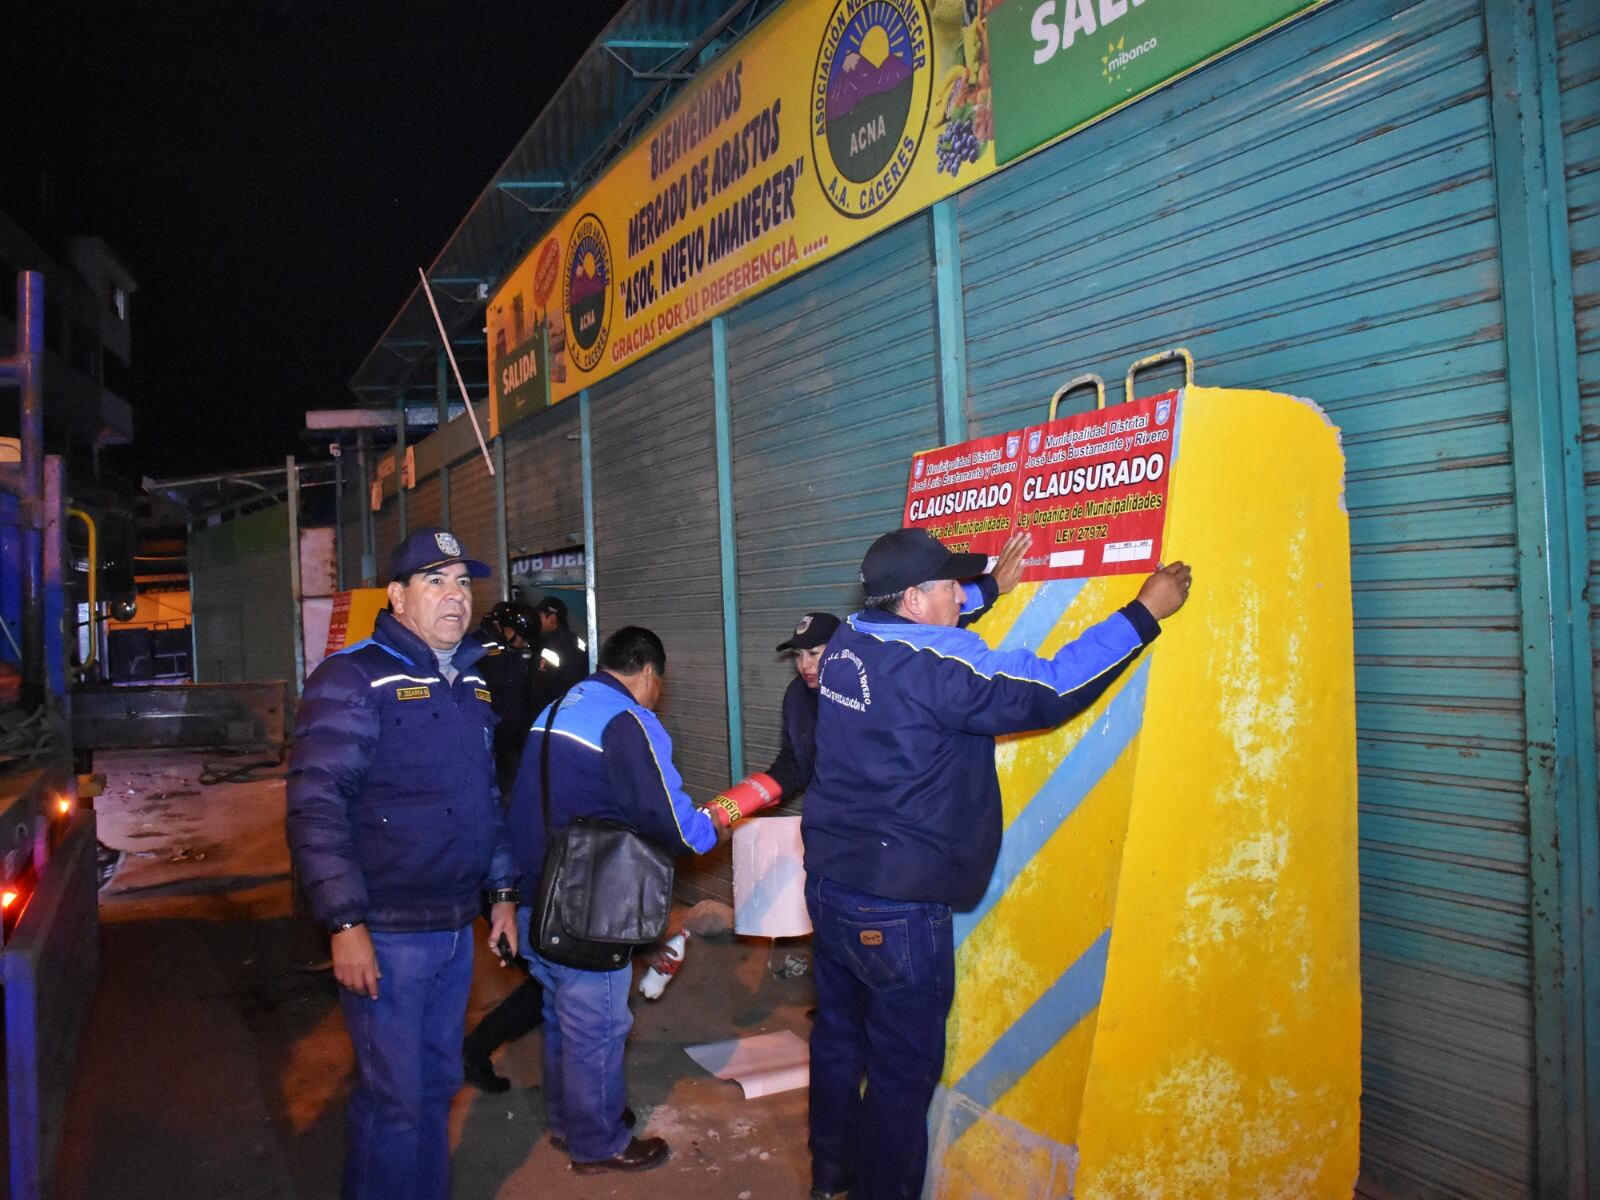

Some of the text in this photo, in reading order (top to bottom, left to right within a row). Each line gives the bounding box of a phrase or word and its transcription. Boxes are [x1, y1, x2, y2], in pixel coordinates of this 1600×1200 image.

[1030, 0, 1146, 65] SAL
[816, 0, 926, 137] ASOCIACIÓN ANECER
[1107, 36, 1157, 72] mibanco
[651, 60, 743, 181] BIENVENIDOS
[850, 115, 886, 157] ACNA
[628, 98, 781, 259] MERCADO DE ABASTOS
[829, 136, 914, 211] A.A. CÁCERES
[620, 260, 658, 319] "ASOC.
[661, 225, 705, 296] NUEVO
[708, 156, 804, 265] AMANECER"
[579, 310, 596, 333] ACNA
[611, 325, 656, 362] GRACIAS
[657, 303, 683, 337] POR
[684, 296, 699, 322] SU
[502, 349, 537, 395] SALIDA
[1025, 429, 1169, 469] José Luis Bustamante y Rivero
[1045, 413, 1150, 449] Municipalidad Distrital
[926, 447, 1003, 476] Municipalidad Distrital
[927, 476, 942, 490] Luis
[942, 468, 985, 487] Bustamante
[984, 468, 991, 480] y
[991, 461, 1018, 477] Rivero
[1022, 452, 1164, 501] CLAUSURADO
[909, 482, 1012, 522] CLAUSURADO
[1016, 512, 1032, 530] Ley
[1071, 502, 1083, 520] de
[1084, 490, 1162, 519] Municipalidades
[944, 523, 953, 537] de
[953, 515, 1010, 538] Municipalidades
[1055, 524, 1109, 544] LEY 27972
